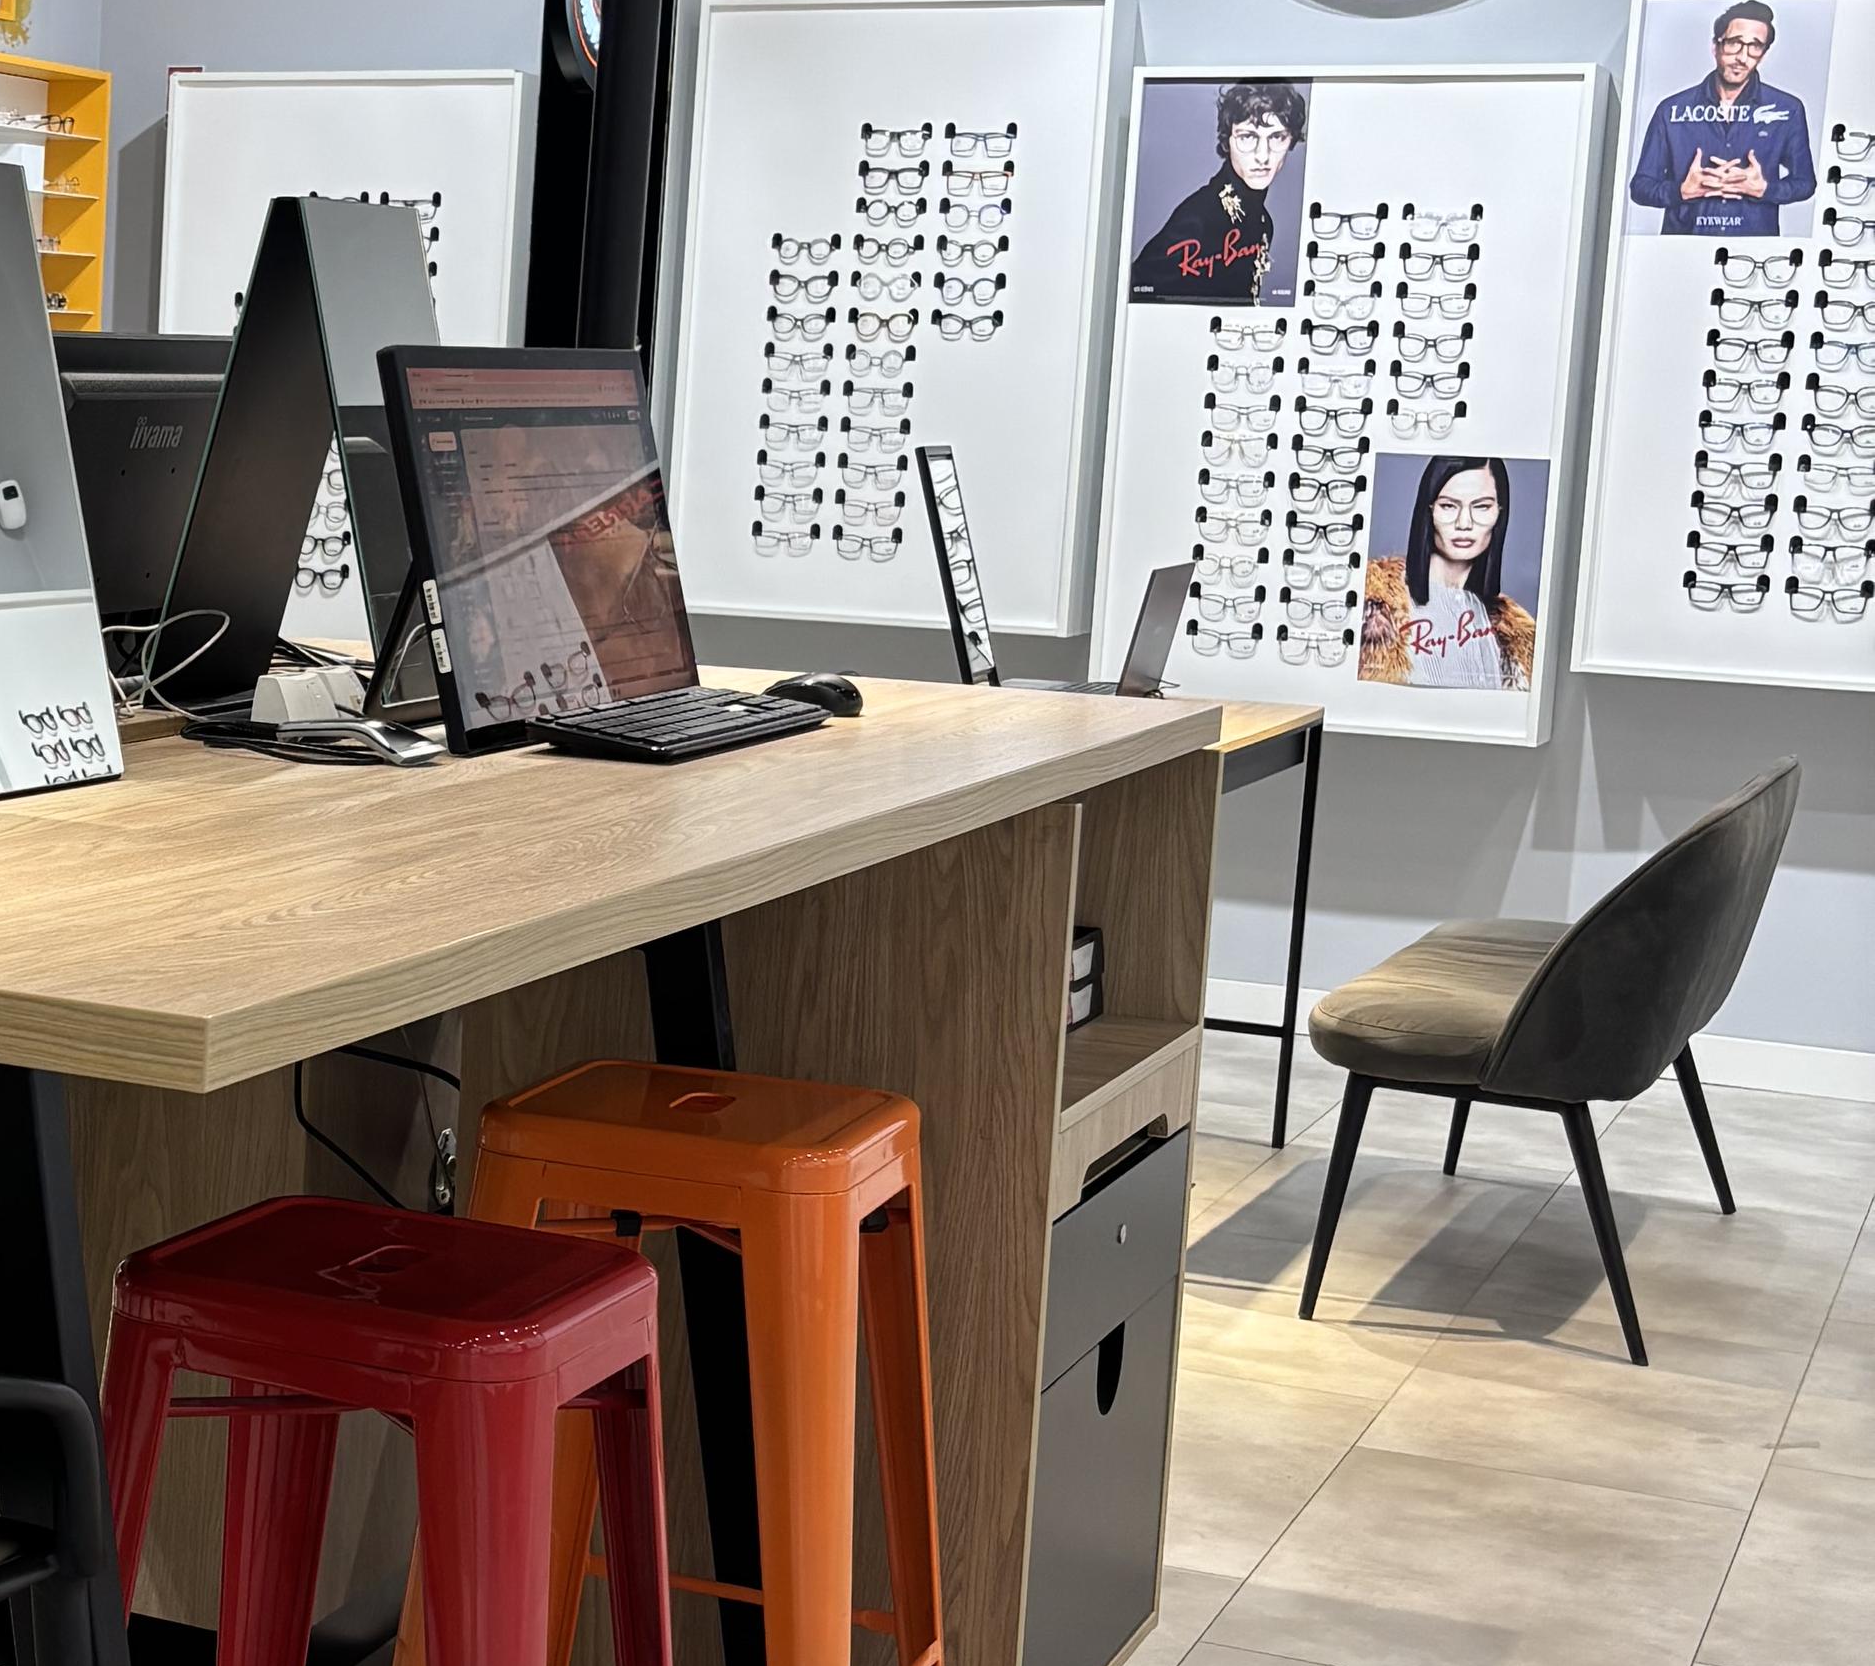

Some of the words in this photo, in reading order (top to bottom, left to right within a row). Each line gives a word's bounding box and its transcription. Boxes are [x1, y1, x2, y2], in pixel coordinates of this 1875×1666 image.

[1670, 105, 1750, 123] LACOSTE
[1166, 228, 1263, 278] Ray-Ban
[130, 416, 183, 449] iiyama
[1399, 610, 1498, 658] Ray-Ban
